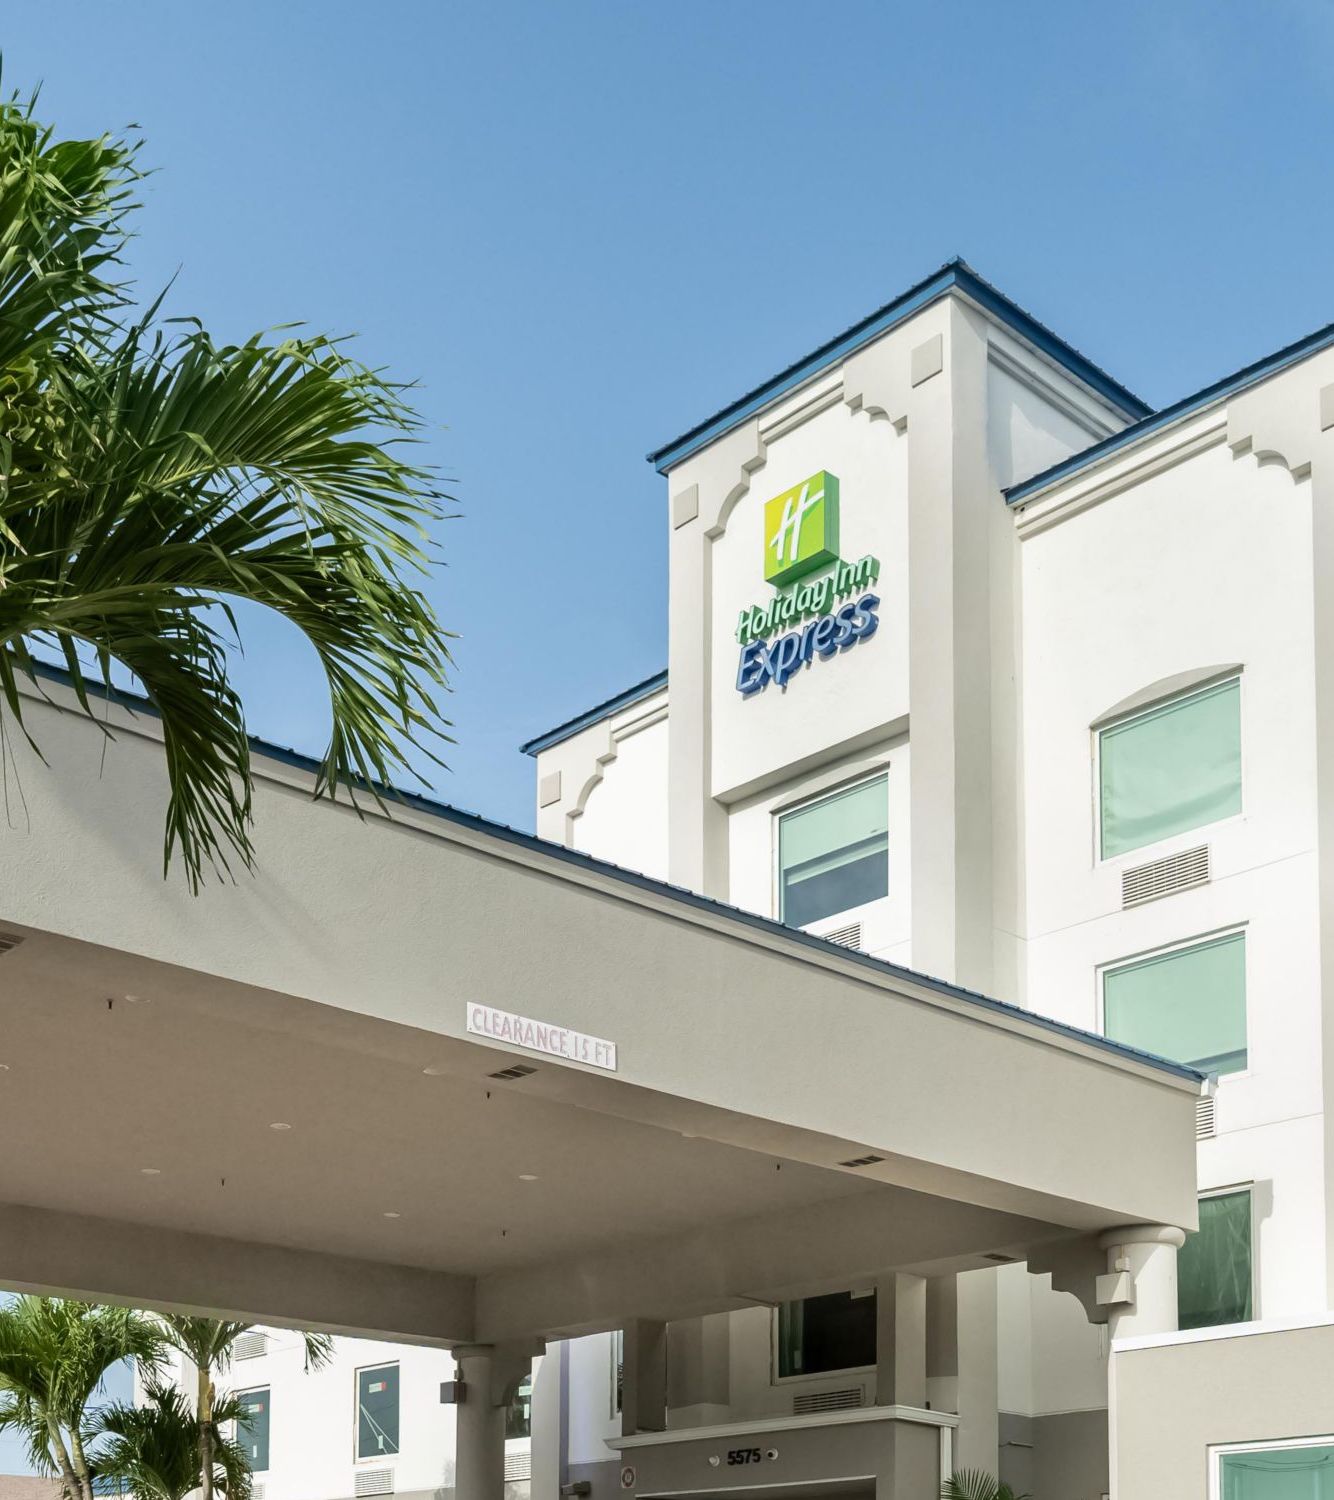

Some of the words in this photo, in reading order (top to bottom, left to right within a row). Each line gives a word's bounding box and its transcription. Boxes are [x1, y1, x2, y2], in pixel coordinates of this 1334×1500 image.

[736, 577, 832, 643] Holiday
[832, 555, 878, 597] Inn
[736, 593, 879, 692] Express
[472, 1007, 568, 1055] CLEARANCE
[595, 1041, 612, 1067] FT
[727, 1448, 761, 1466] 5575
